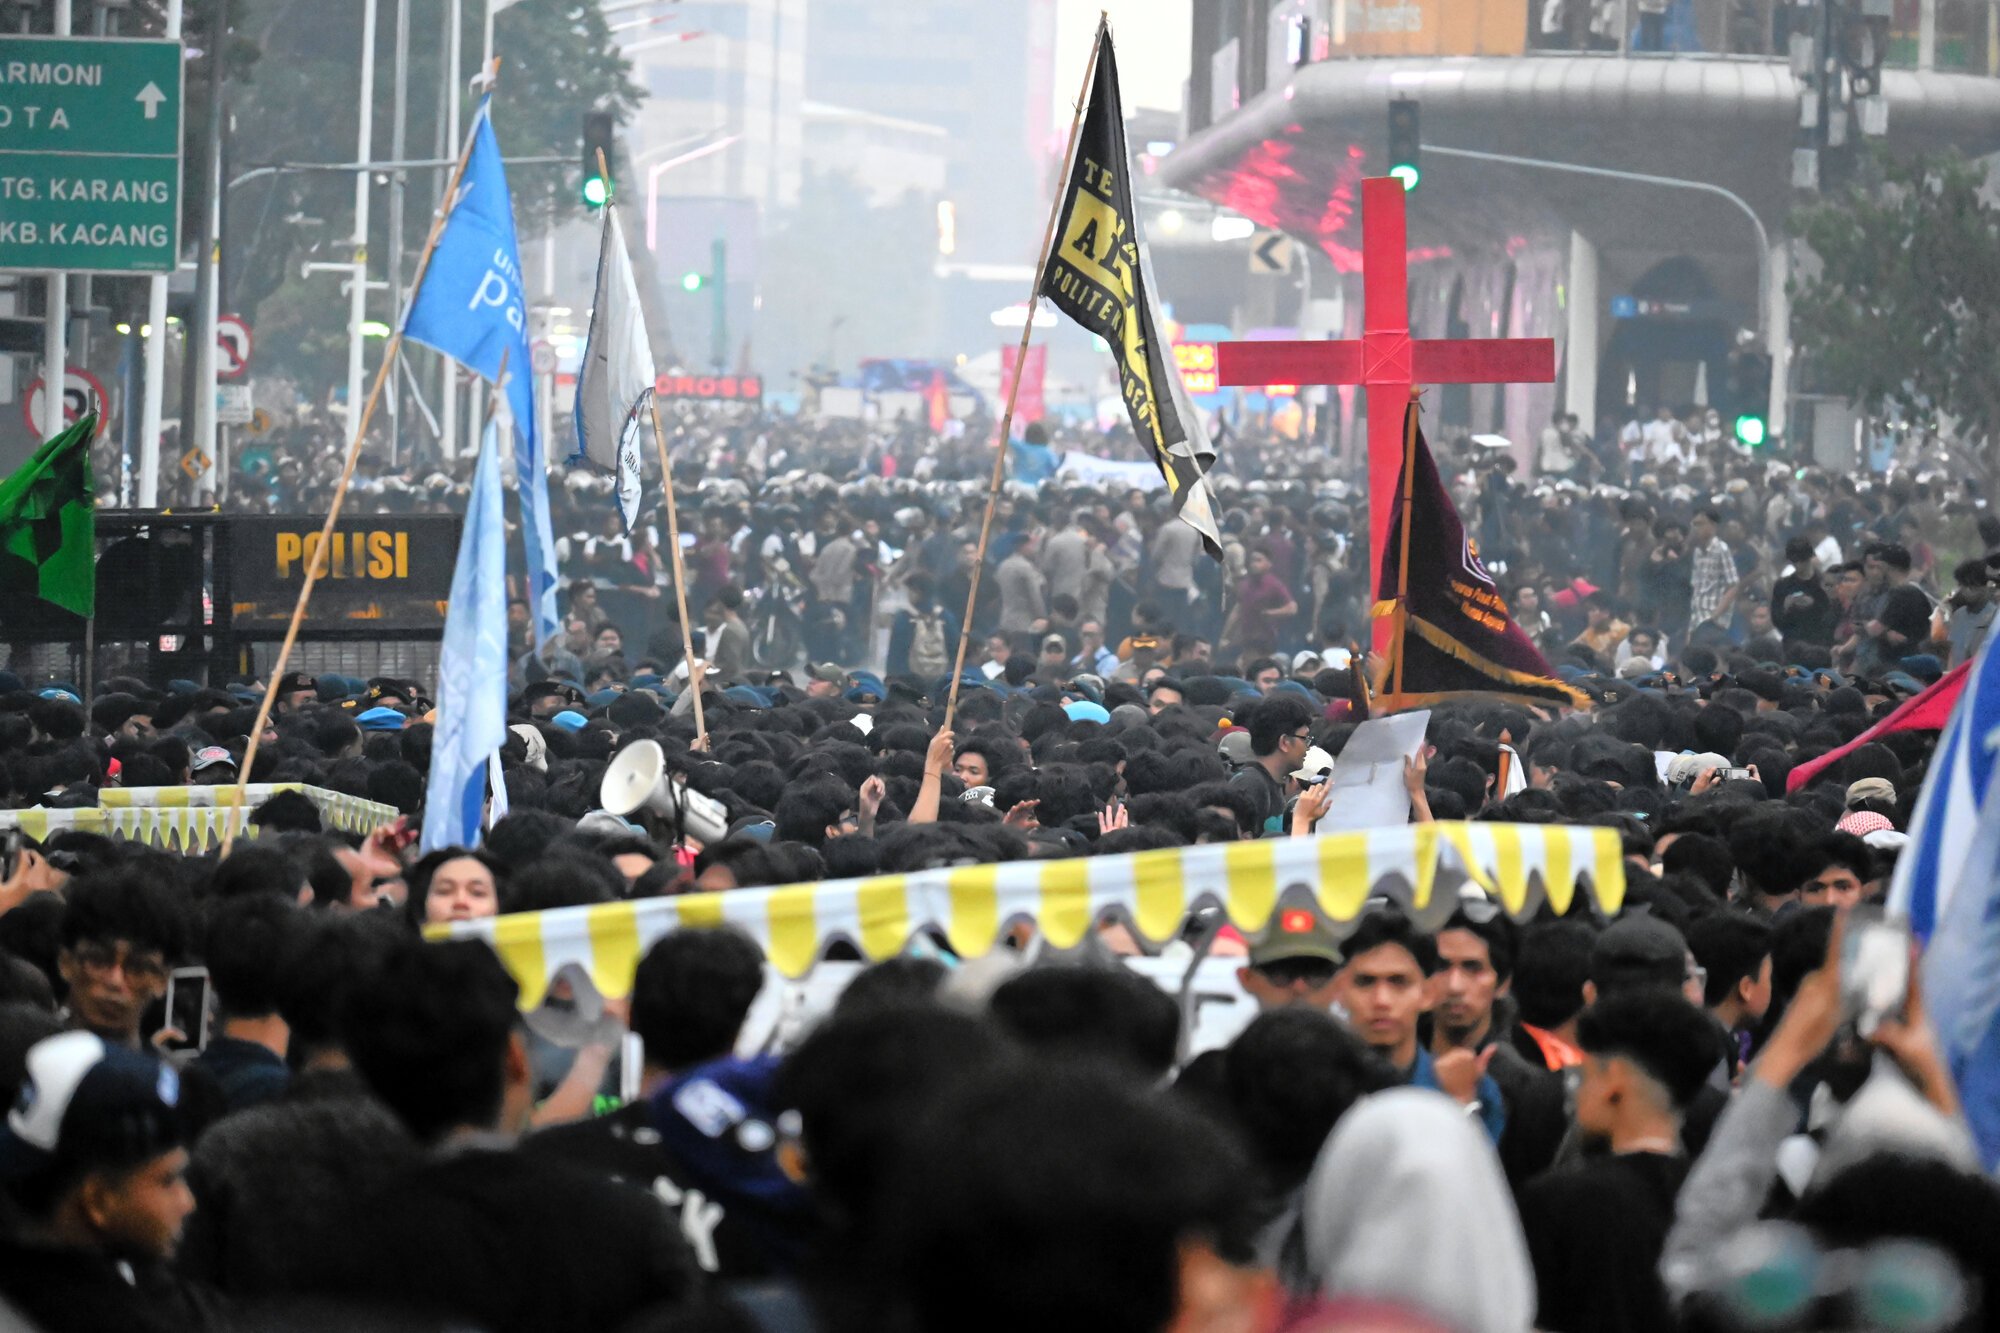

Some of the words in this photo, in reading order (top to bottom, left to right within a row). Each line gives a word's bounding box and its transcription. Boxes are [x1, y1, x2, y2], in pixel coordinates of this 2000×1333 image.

[1, 176, 42, 200] TG.
[50, 178, 169, 204] KARANG
[50, 223, 168, 248] KACANG
[276, 531, 409, 580] POLISI
